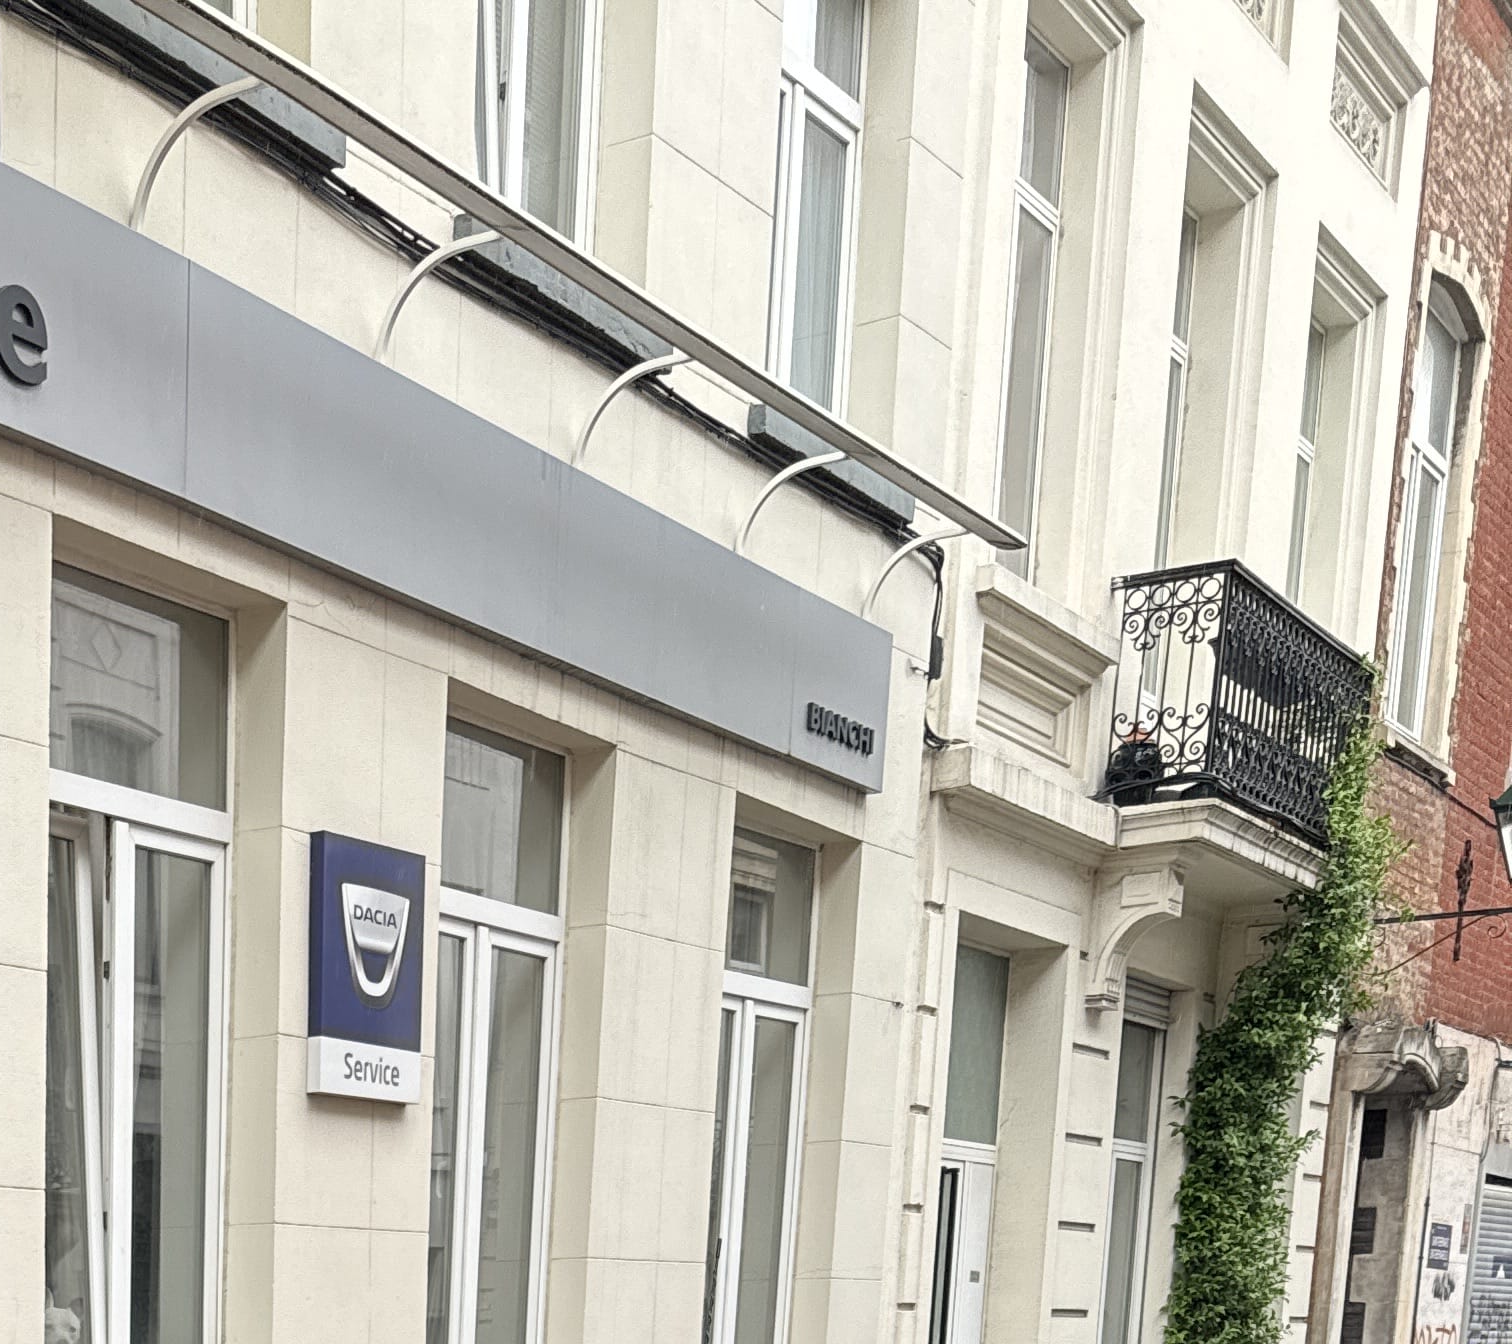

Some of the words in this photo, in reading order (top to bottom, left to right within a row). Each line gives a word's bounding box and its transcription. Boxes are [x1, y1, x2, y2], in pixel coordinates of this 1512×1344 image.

[806, 702, 875, 758] BIANCHI
[353, 904, 397, 929] DACIA
[343, 1052, 400, 1087] Service
